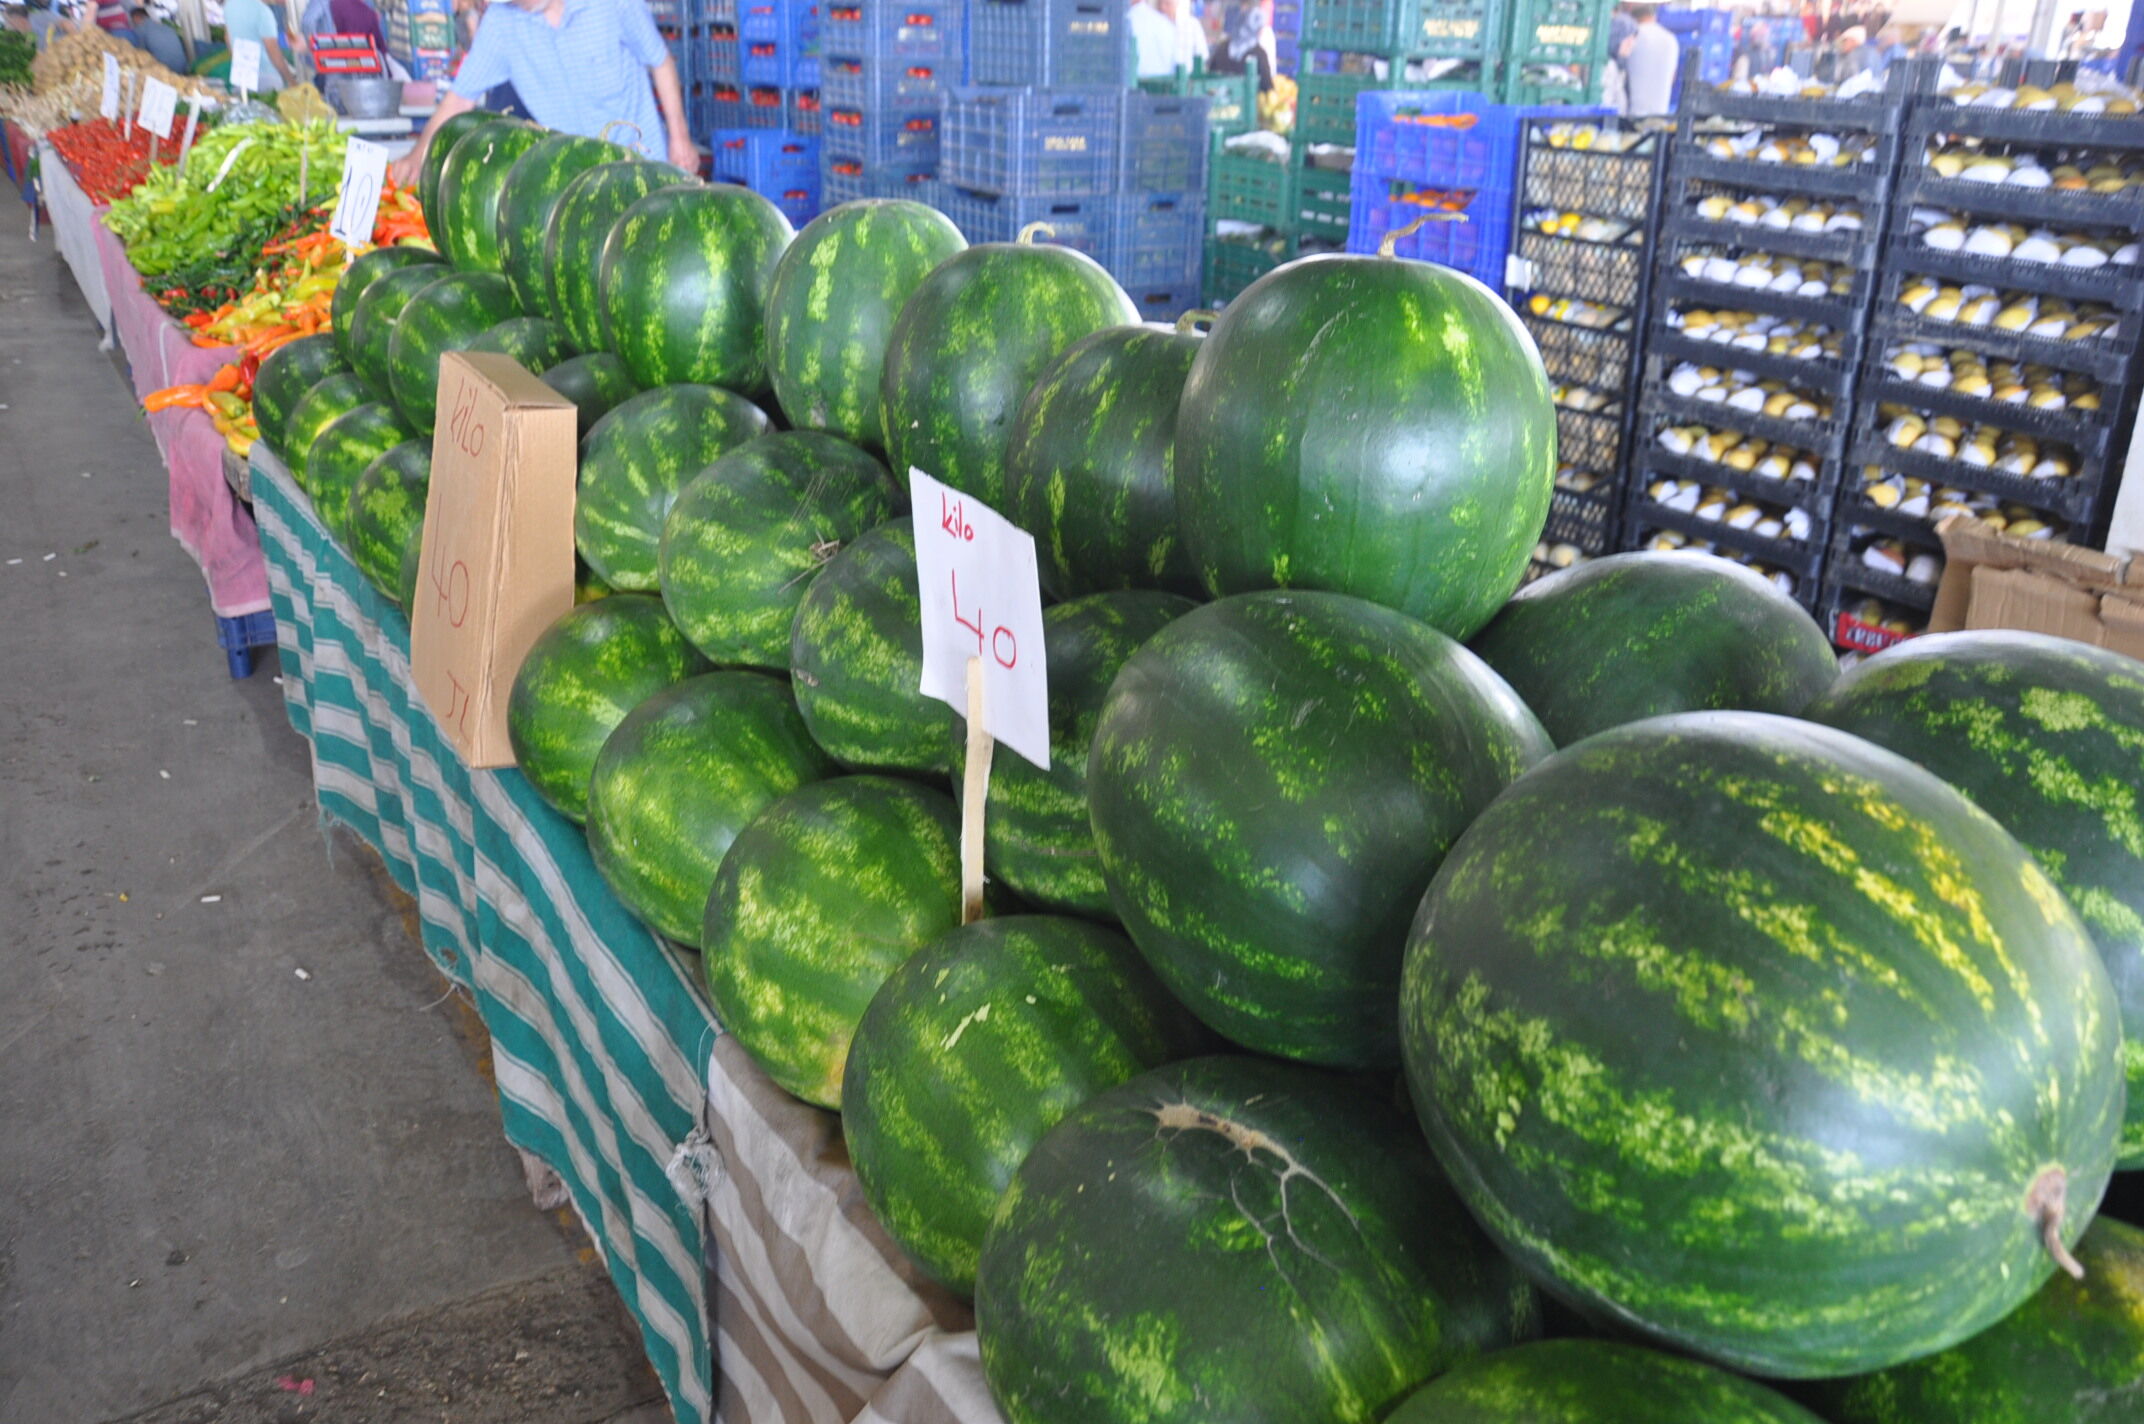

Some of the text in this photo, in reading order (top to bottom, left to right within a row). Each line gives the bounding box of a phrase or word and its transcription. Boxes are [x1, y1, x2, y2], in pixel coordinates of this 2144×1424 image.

[430, 492, 469, 628] 40
[942, 490, 974, 542] kilo
[951, 567, 1017, 671] 40
